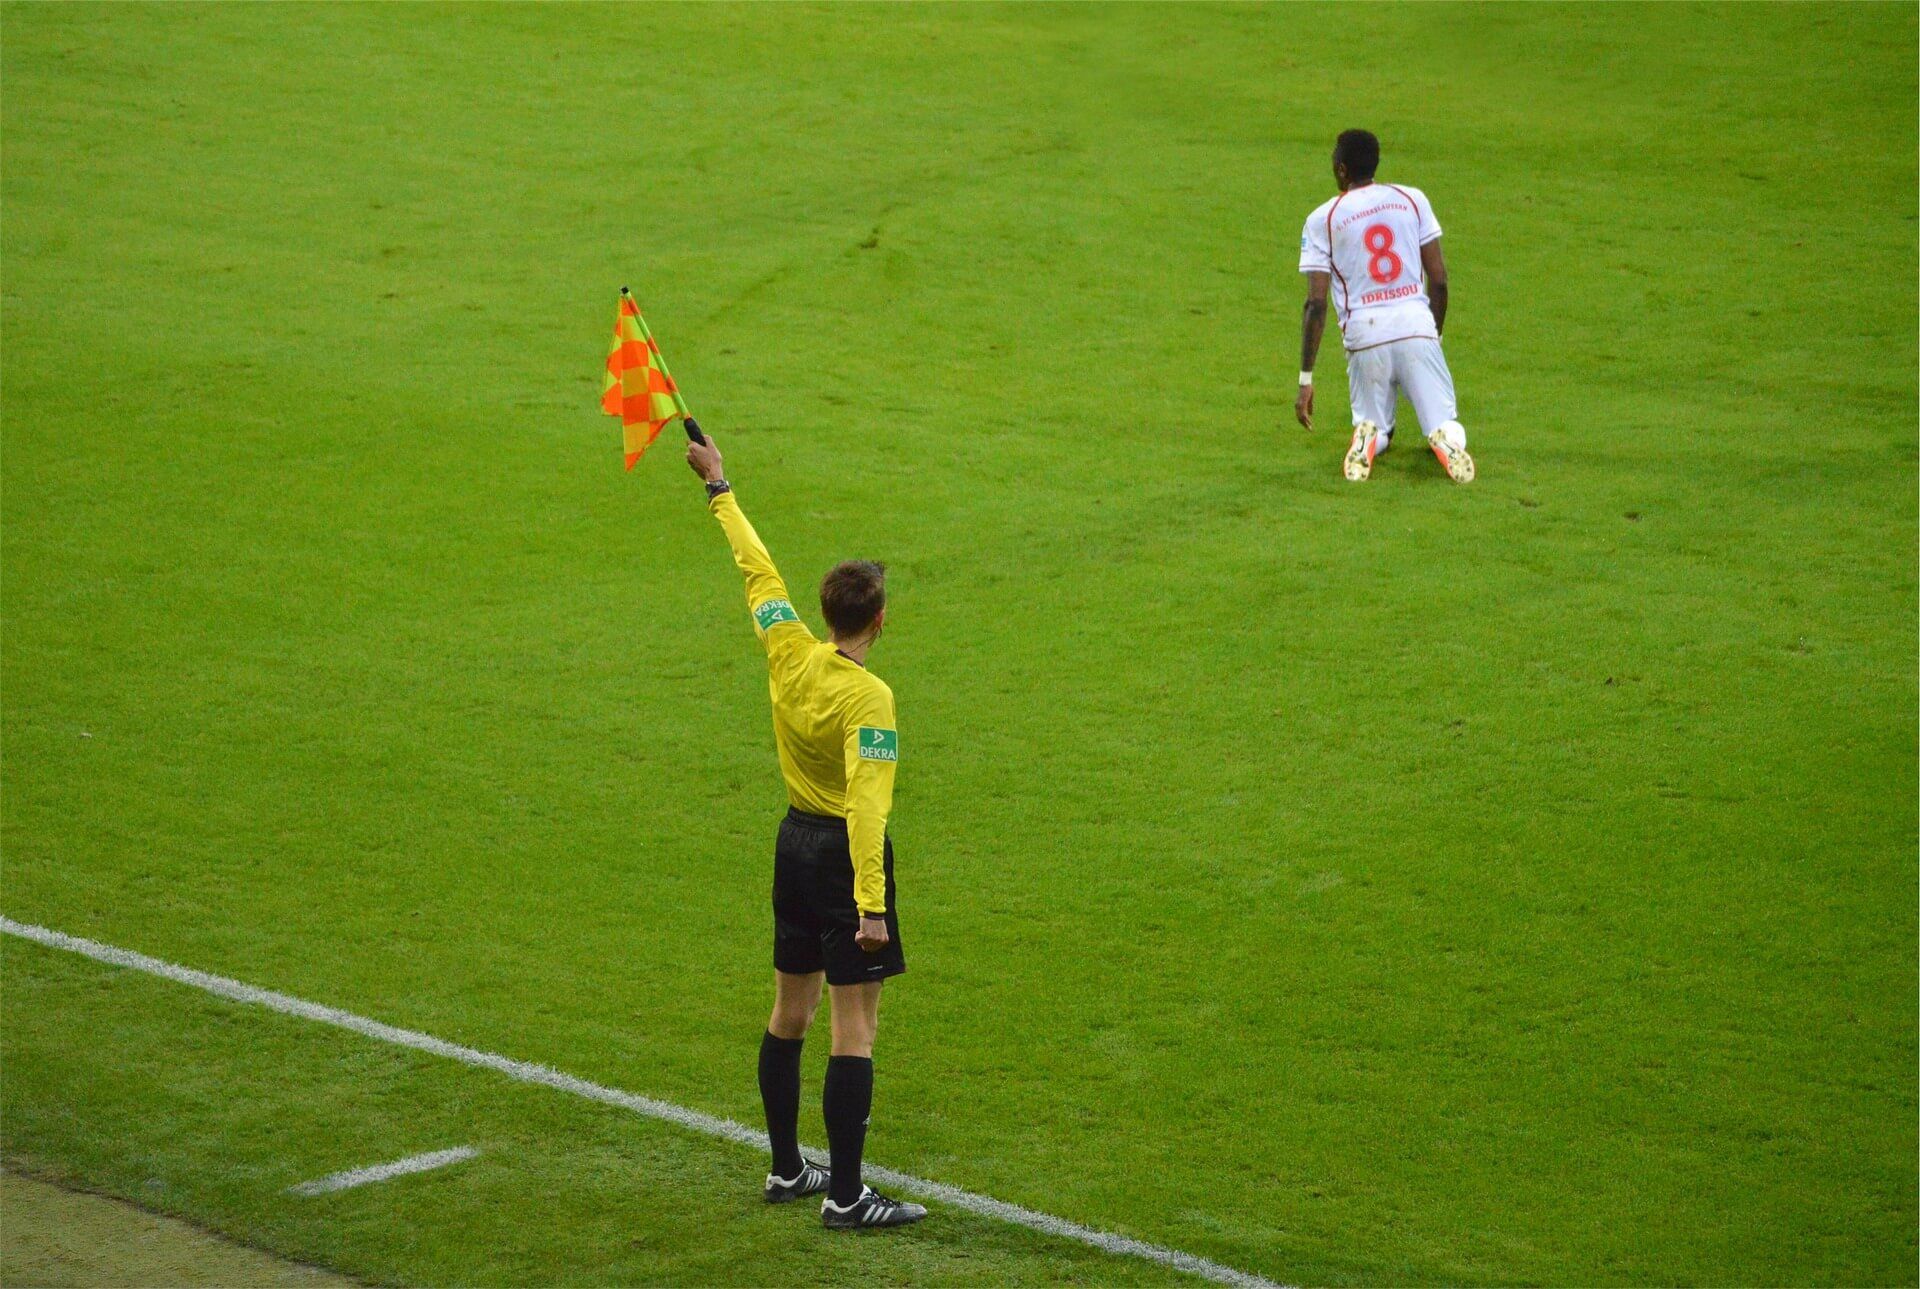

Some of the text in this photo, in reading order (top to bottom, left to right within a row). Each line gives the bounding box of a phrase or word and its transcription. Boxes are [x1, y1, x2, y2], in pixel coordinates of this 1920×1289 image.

[1364, 224, 1403, 284] 8
[1361, 284, 1418, 304] IDRISSOU
[755, 600, 790, 616] DEKRA
[860, 746, 896, 760] DEKRA
